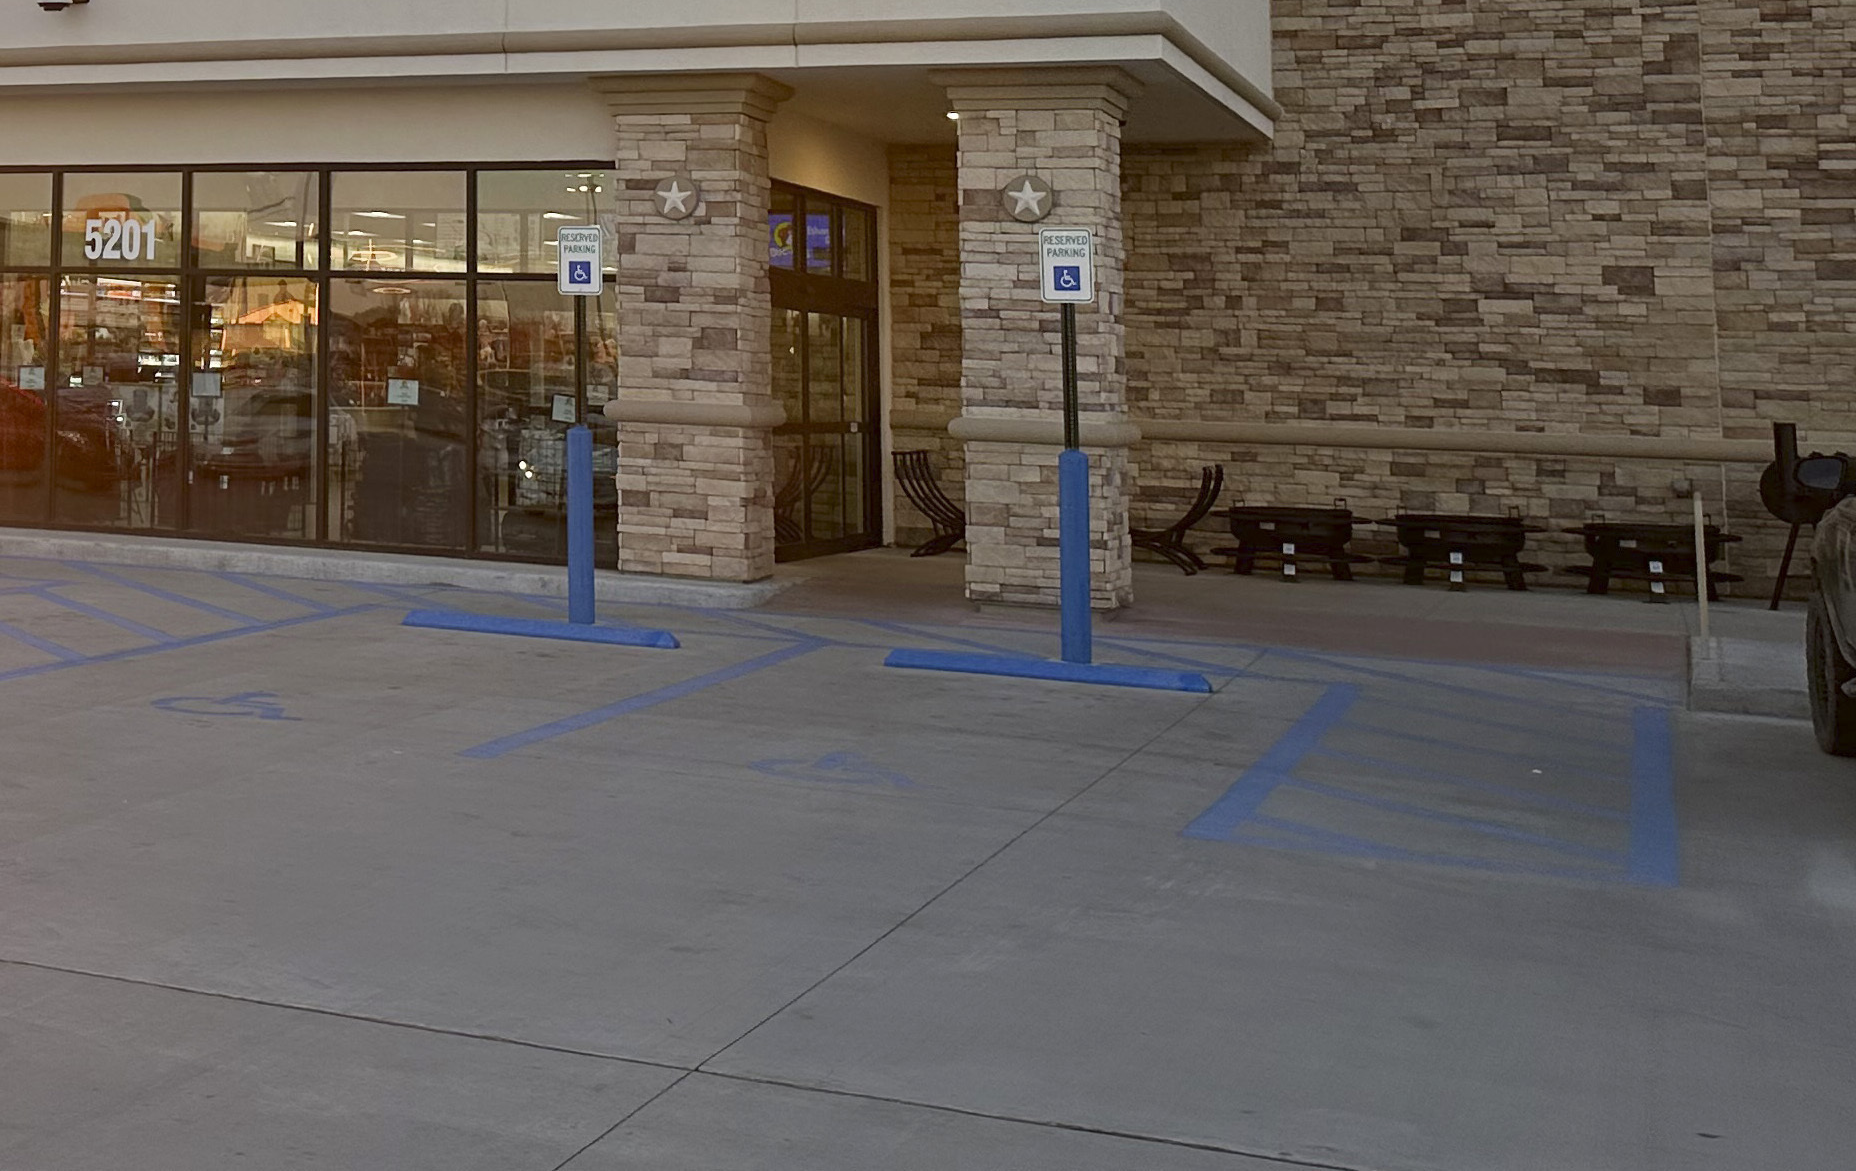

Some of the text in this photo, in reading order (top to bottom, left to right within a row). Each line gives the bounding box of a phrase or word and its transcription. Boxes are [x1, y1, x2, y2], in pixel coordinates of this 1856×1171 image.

[85, 218, 156, 260] 5201
[561, 232, 598, 243] RESERVED
[1043, 235, 1088, 245] RESERVED
[563, 244, 596, 254] PARKING
[1046, 248, 1086, 258] PARKING
